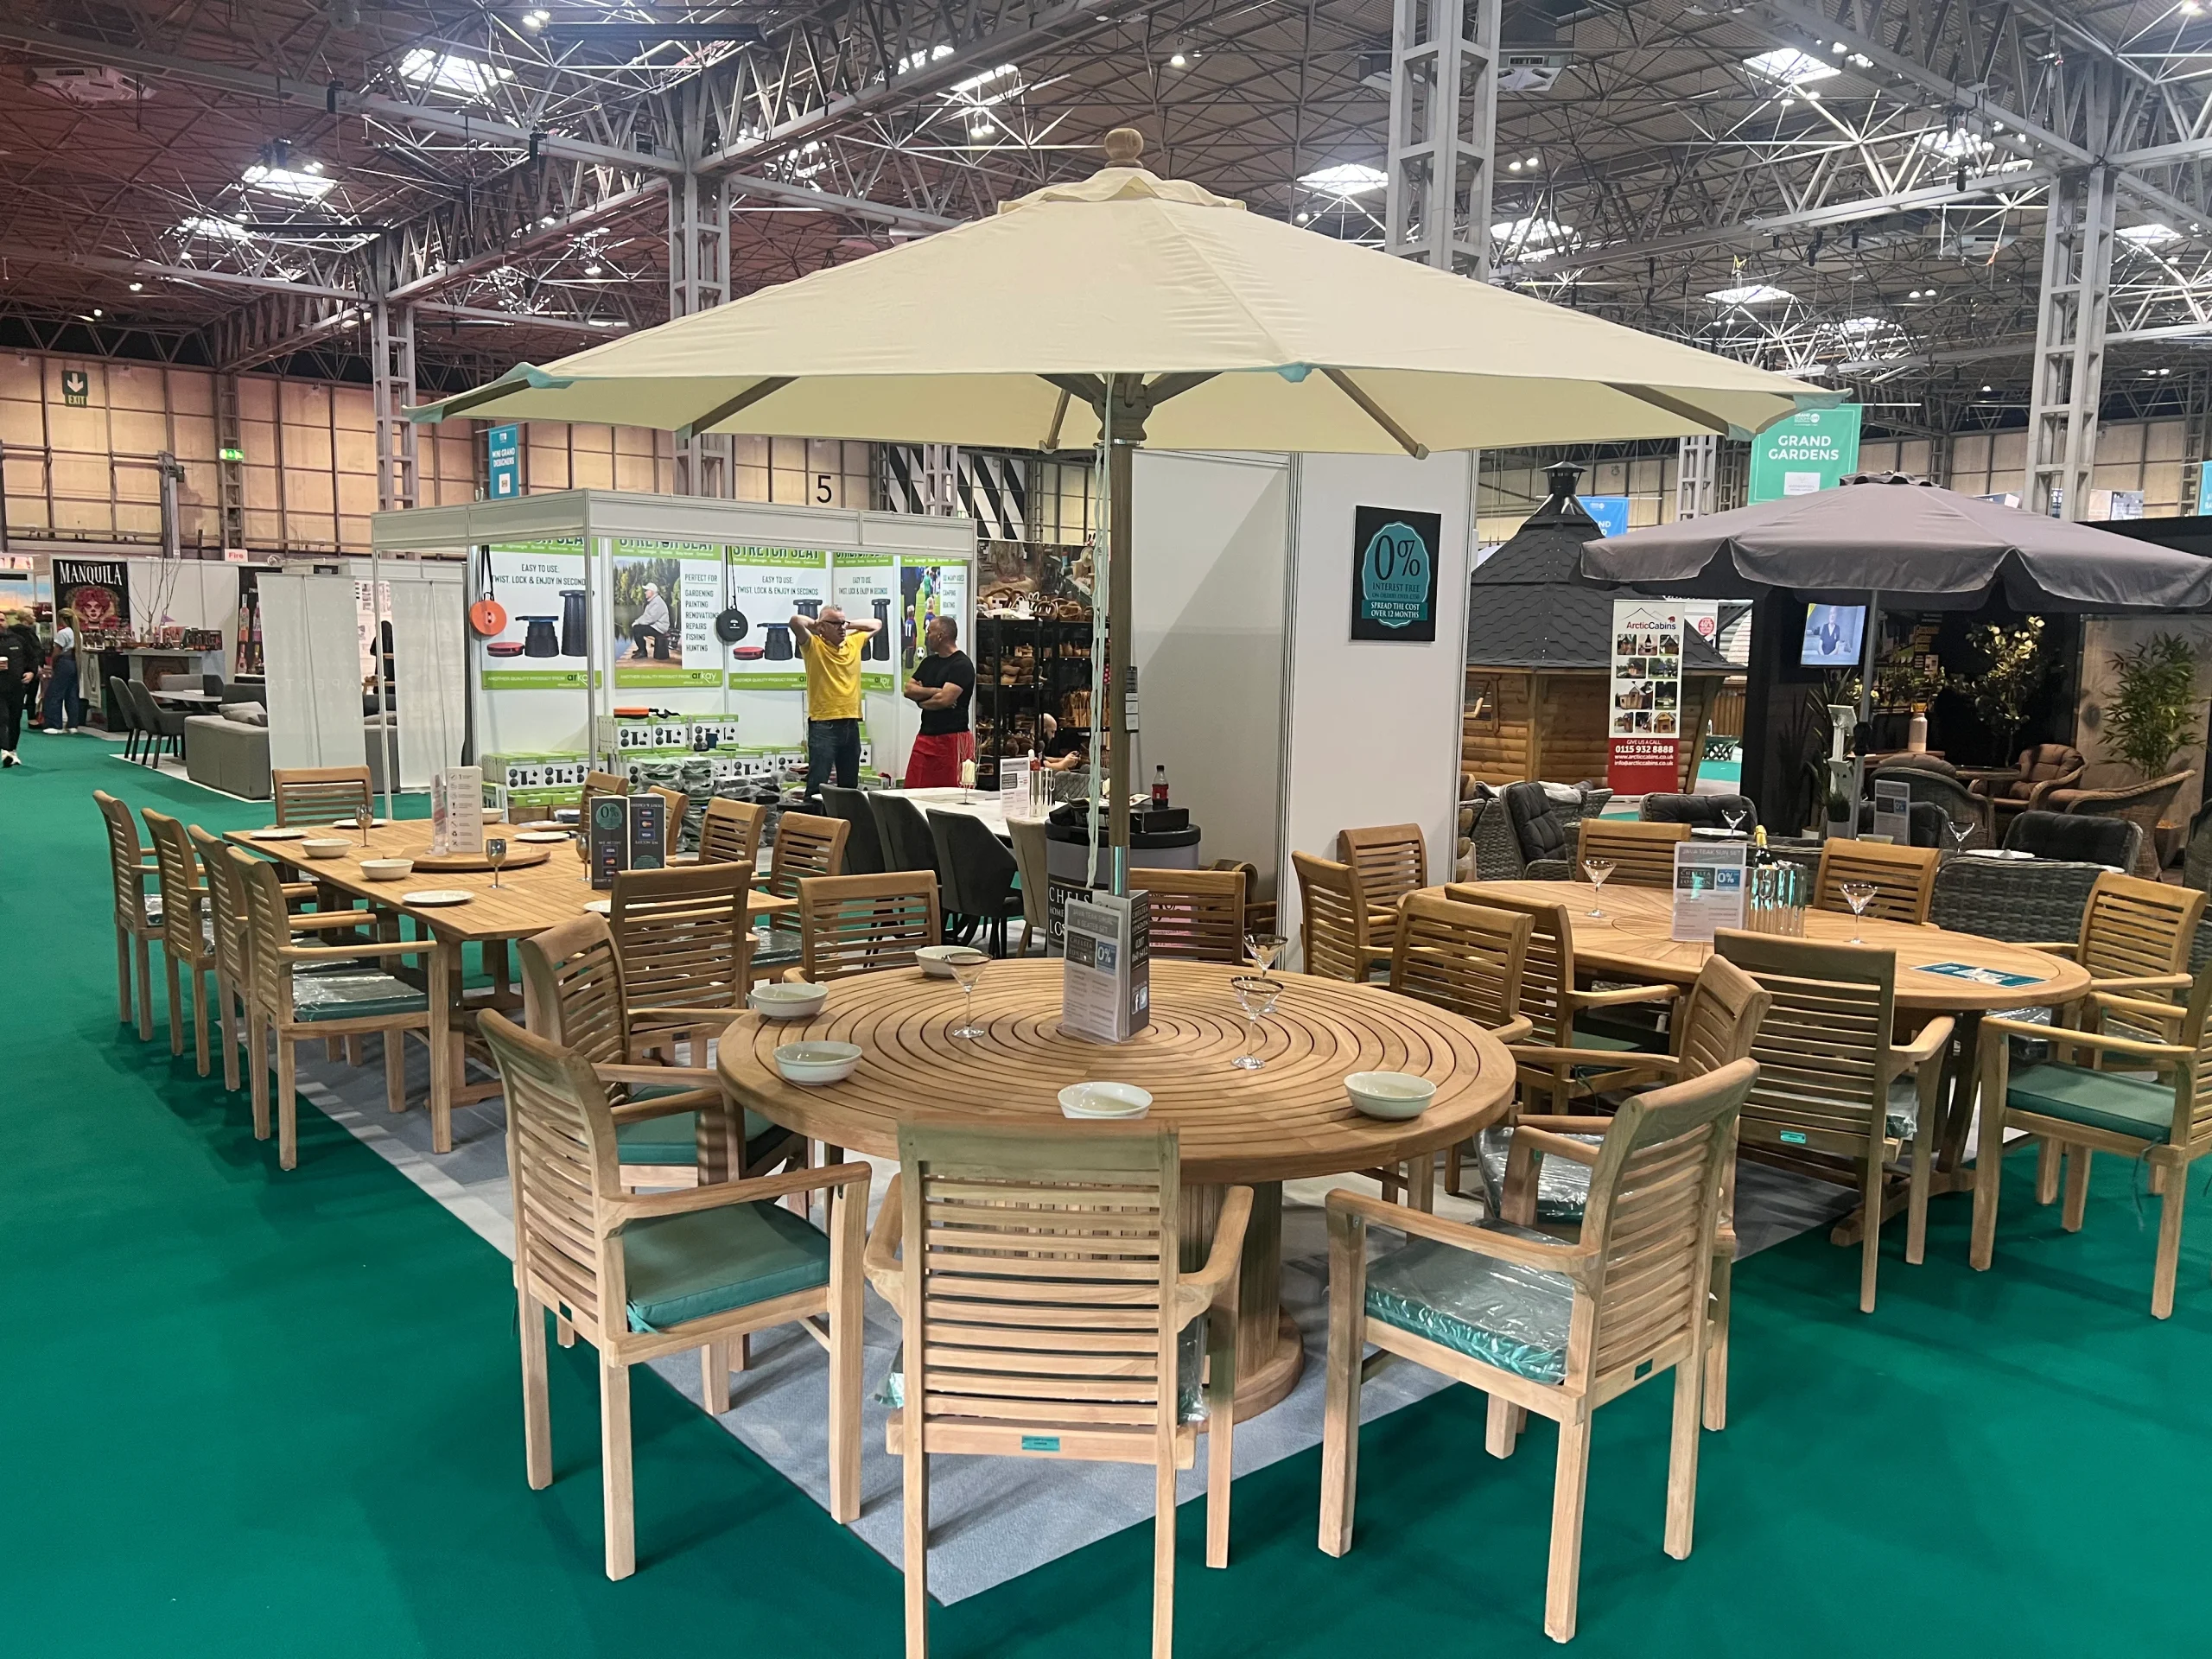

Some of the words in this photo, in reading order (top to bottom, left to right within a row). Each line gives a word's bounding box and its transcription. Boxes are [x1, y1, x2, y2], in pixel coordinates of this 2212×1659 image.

[68, 394, 85, 405] EXIT
[1778, 435, 1831, 446] GRAND
[501, 447, 516, 457] GRAND
[1768, 448, 1839, 460] GARDENS
[817, 475, 832, 503] 5
[1374, 534, 1421, 581] 0%
[59, 561, 122, 586] MANQUILA
[521, 564, 537, 572] EASY
[512, 575, 527, 584] LOCK
[685, 574, 707, 582] PERFECT
[1372, 582, 1404, 592] INTEREST
[1405, 584, 1421, 592] FREE
[1626, 621, 1676, 630] ArcticCabins
[692, 671, 717, 683] arkay
[1717, 872, 1735, 884] 0%
[1097, 947, 1111, 963] 0%
